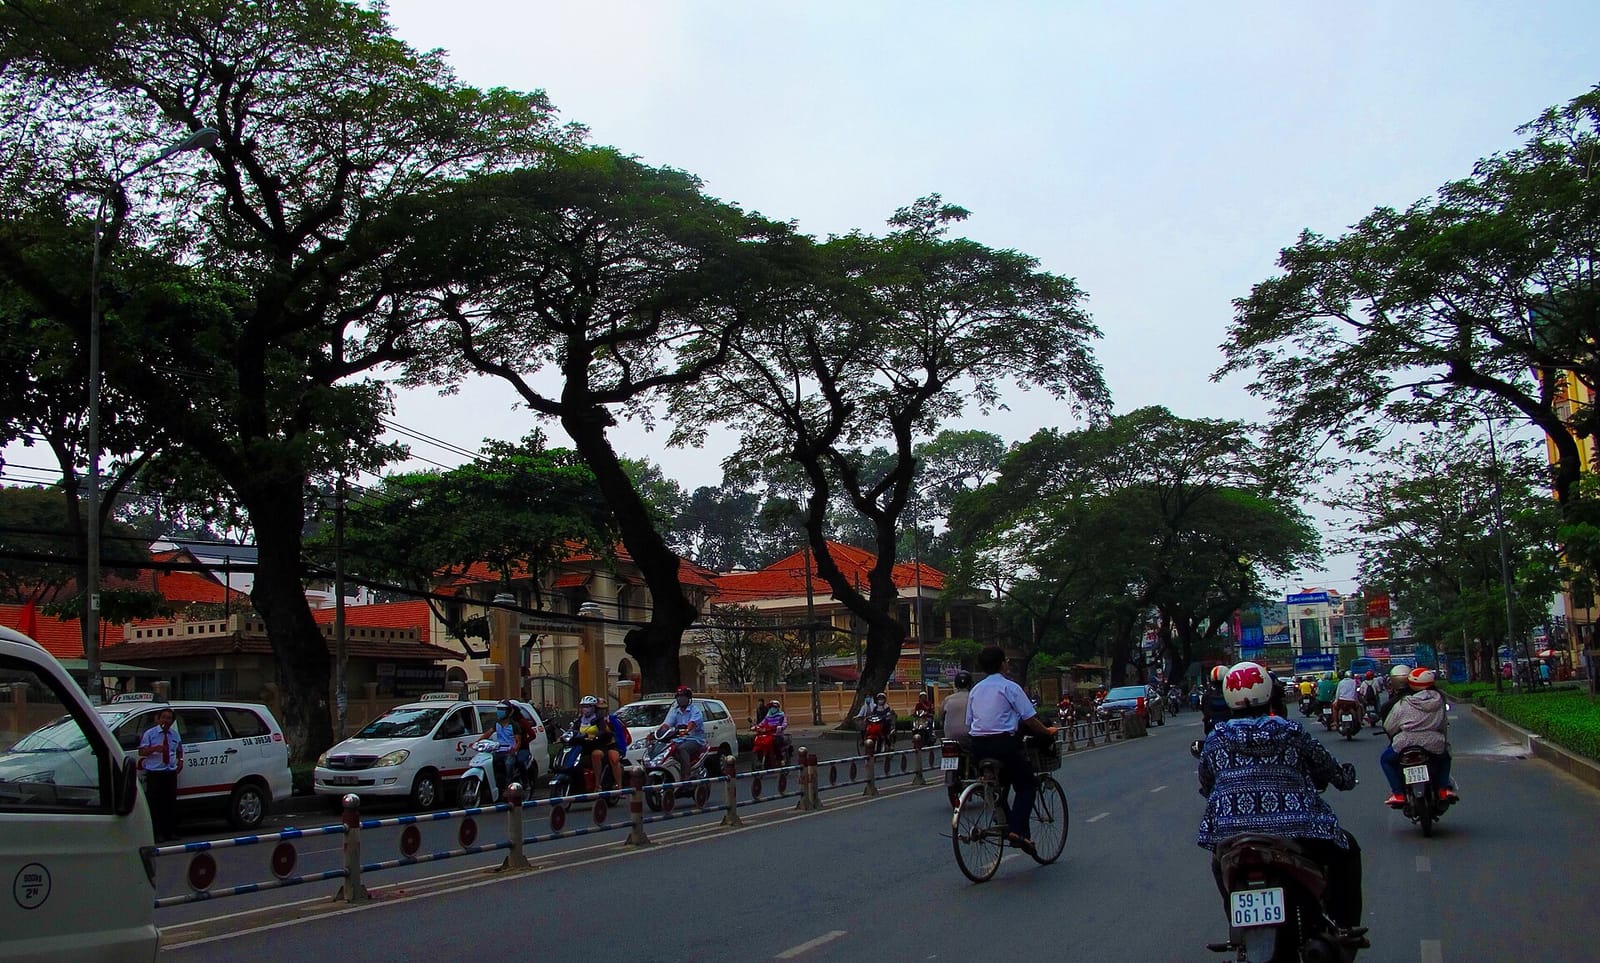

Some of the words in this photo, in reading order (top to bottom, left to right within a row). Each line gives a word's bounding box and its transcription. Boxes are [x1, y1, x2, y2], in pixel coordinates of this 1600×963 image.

[1295, 656, 1332, 664] Sacombank
[210, 756, 218, 765] 27
[220, 754, 228, 764] 27
[1239, 891, 1273, 908] 59-T1
[1235, 906, 1281, 924] 061.69
